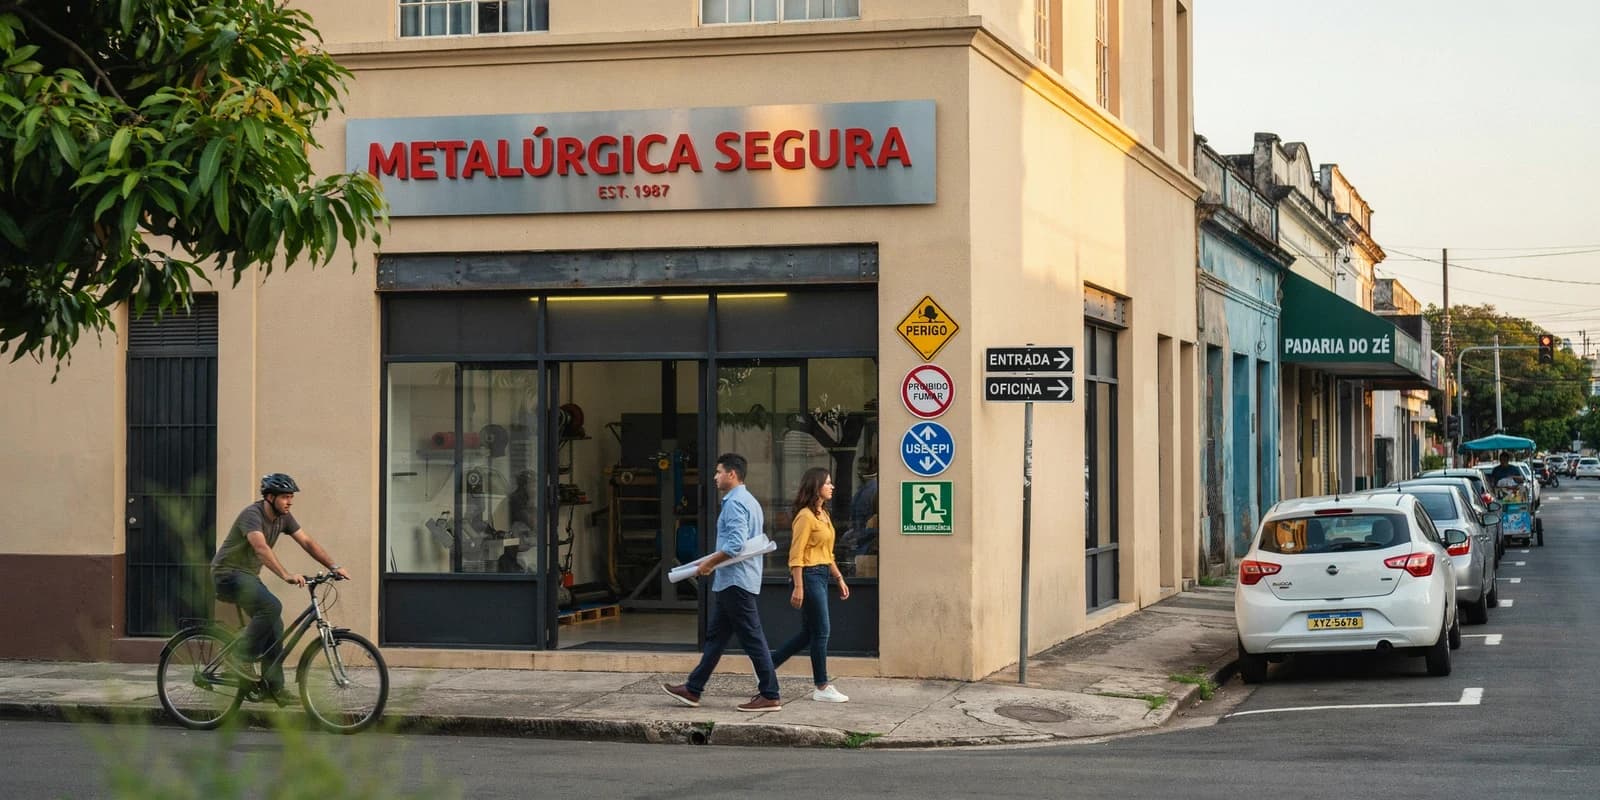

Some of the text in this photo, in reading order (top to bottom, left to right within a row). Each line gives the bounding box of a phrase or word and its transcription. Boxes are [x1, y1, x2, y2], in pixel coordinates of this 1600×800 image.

[368, 126, 912, 180] METALÚRGICA SEGURA
[598, 184, 670, 199] EST. 1987
[906, 325, 947, 336] PERIGO
[1285, 338, 1344, 354] PADARIA
[1349, 338, 1368, 354] DO
[1372, 334, 1390, 354] ZÉ
[990, 354, 1050, 366] ENTRADA
[990, 383, 1042, 395] OFICINA
[913, 392, 943, 401] FUMAR
[906, 443, 950, 454] USE EPI
[1313, 618, 1358, 628] XYZ-5678
